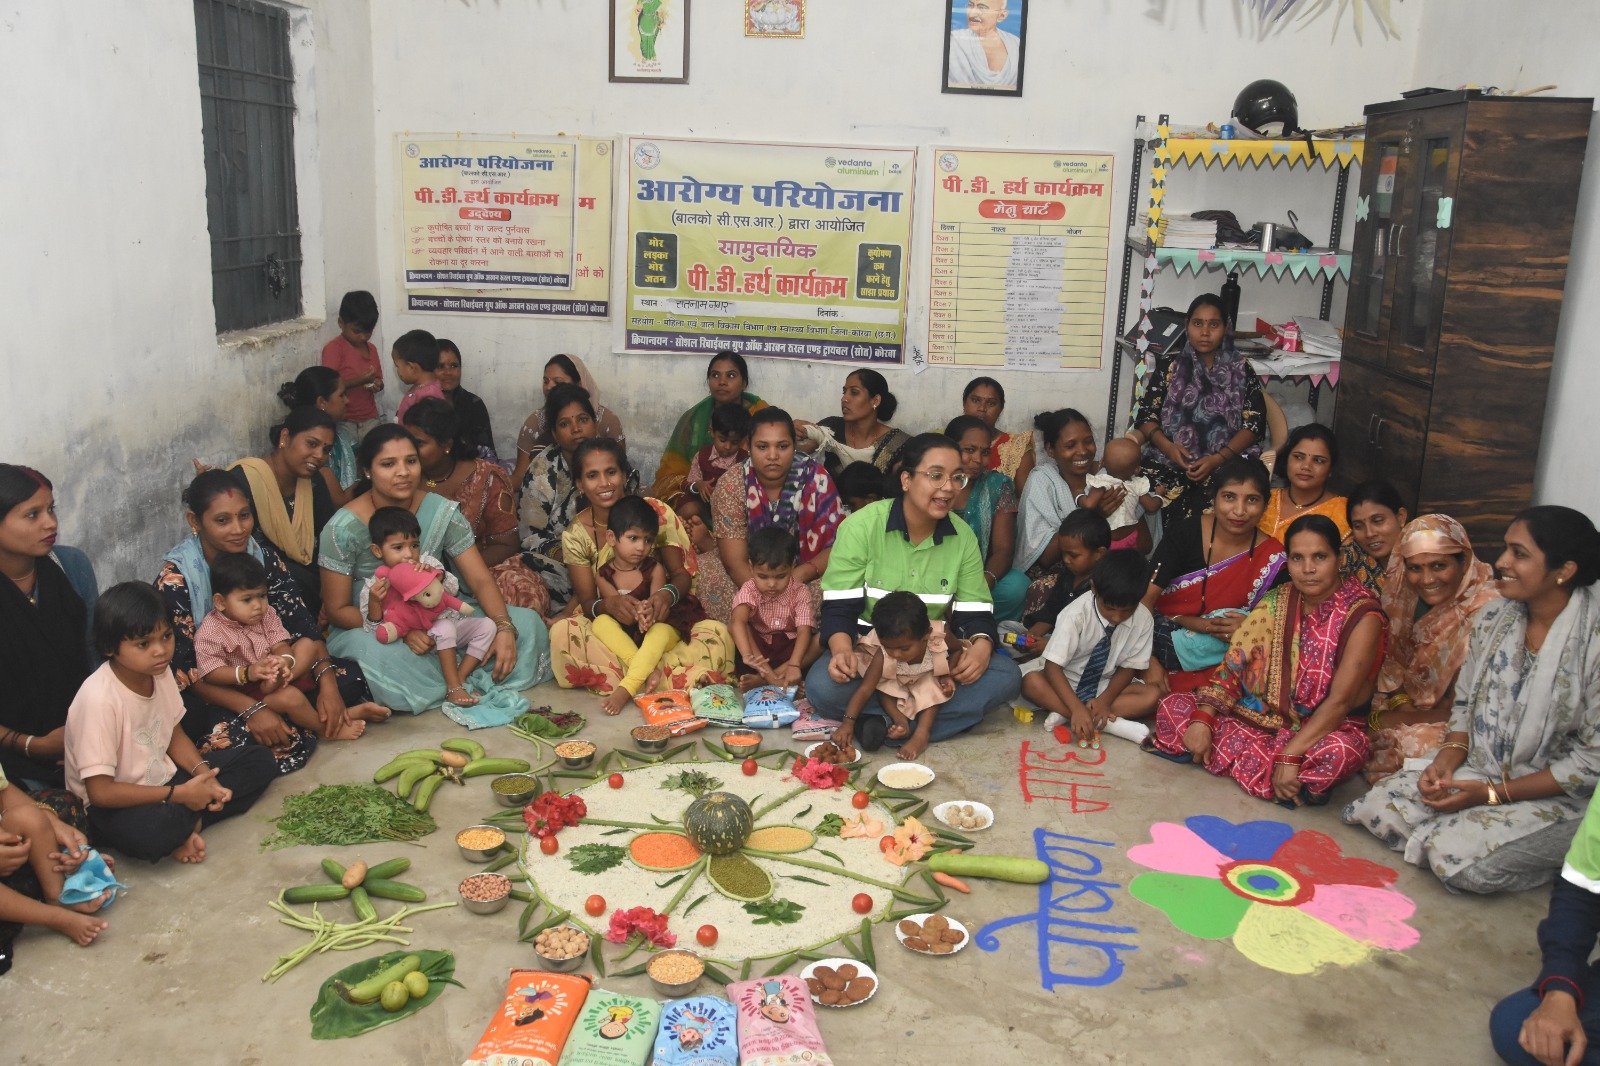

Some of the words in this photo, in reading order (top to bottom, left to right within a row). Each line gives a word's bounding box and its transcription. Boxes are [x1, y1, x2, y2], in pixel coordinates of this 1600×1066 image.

[419, 154, 473, 168] आरोग्य
[478, 155, 554, 171] परियोजना
[837, 159, 872, 167] vedanta
[837, 167, 879, 176] aluminium
[1003, 177, 1028, 195] हर्थ
[1034, 178, 1104, 197] कार्यक्रम
[494, 189, 560, 206] कार्यक्रम
[636, 175, 743, 206] आरोग्य
[752, 180, 903, 213] परियोजना
[1022, 202, 1051, 215] चार्ट
[671, 208, 712, 227] (बालको
[716, 213, 784, 232] सी.एस.आर.)
[788, 216, 810, 231] द्वारा
[815, 217, 866, 233] आयोजित
[427, 223, 453, 234] कुपोषित
[454, 223, 471, 232] बच्चों
[428, 235, 446, 243] बच्चों
[447, 235, 454, 243] के
[456, 235, 473, 243] पोषण
[492, 236, 502, 244] को
[526, 238, 545, 246] रखना
[648, 236, 664, 248] मोर
[454, 245, 478, 255] परिवर्तन
[507, 248, 524, 257] वाली
[554, 249, 564, 259] को
[717, 236, 817, 263] सामुदायिक
[867, 247, 892, 260] कुपोषण
[428, 258, 450, 266] रोकना
[460, 260, 468, 268] दूर
[648, 261, 663, 271] मोर
[873, 262, 885, 270] कम
[592, 267, 604, 278] को
[776, 269, 848, 298] कार्यक्रम
[866, 273, 880, 283] करने
[882, 274, 891, 288] हेतु
[590, 303, 605, 312] कोरबा
[641, 299, 658, 307] स्थान
[817, 307, 839, 317] दिनांक
[631, 316, 654, 326] सहयोग
[663, 317, 684, 327] महिला
[687, 319, 697, 329] एवं
[718, 320, 740, 330] विकास
[743, 321, 764, 331] विभाग
[807, 324, 828, 334] विभाग
[631, 333, 668, 346] क्रियान्वयन
[675, 335, 698, 348] सोशल
[746, 339, 762, 351] ऑफ
[764, 342, 786, 353] अरबन
[806, 345, 821, 354] एण्ड
[822, 345, 848, 356] ट्रायबल
[874, 346, 896, 358] कोरबा
[1018, 741, 1111, 814] माह
[975, 828, 1139, 992] पोषण
